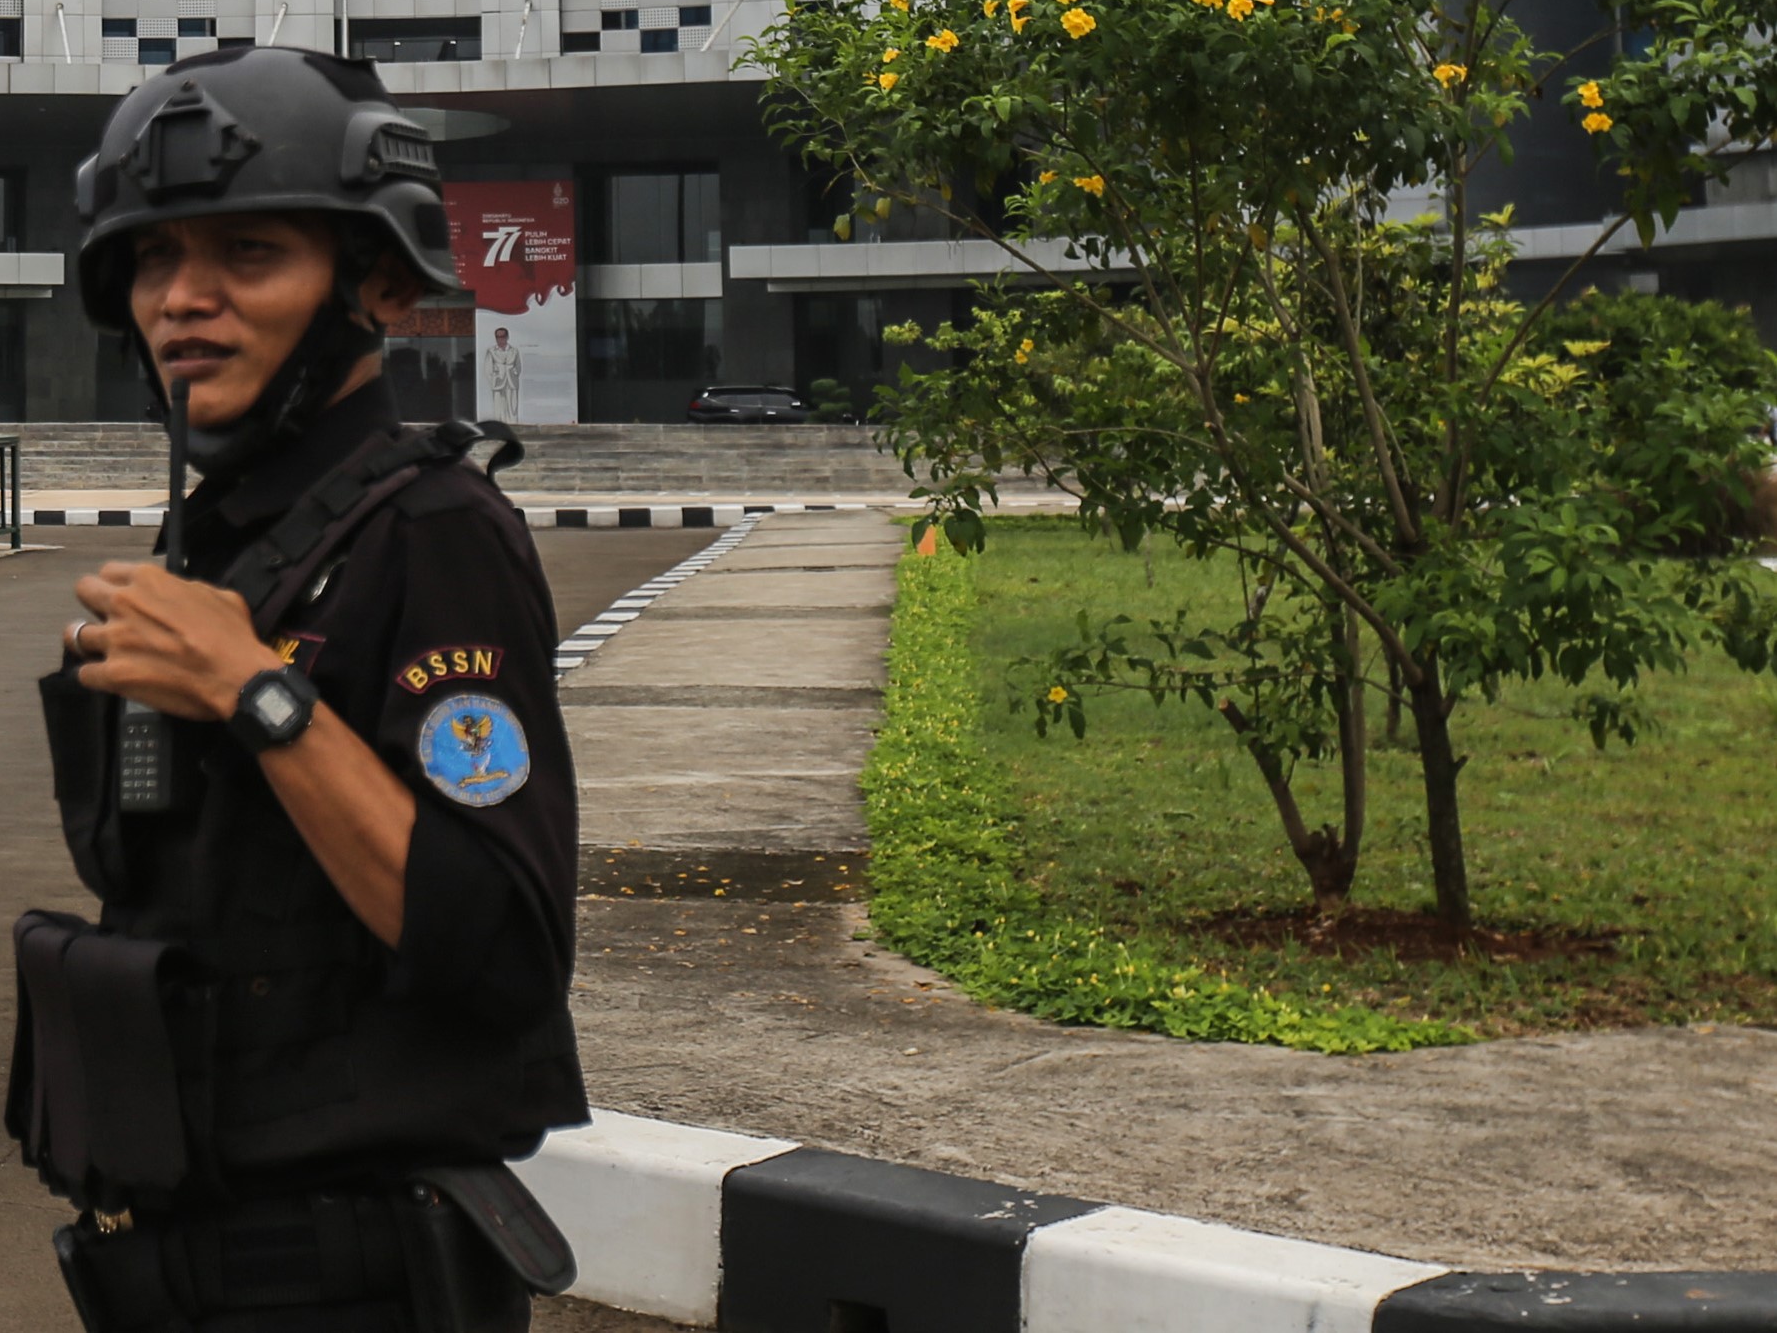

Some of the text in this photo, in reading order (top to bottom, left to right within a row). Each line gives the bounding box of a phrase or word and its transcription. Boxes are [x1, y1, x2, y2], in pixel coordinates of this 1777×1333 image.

[553, 197, 569, 205] G20
[547, 238, 571, 246] CEPAT
[482, 226, 522, 267] 77
[525, 254, 547, 262] LEBIH
[406, 650, 492, 689] BSSN
